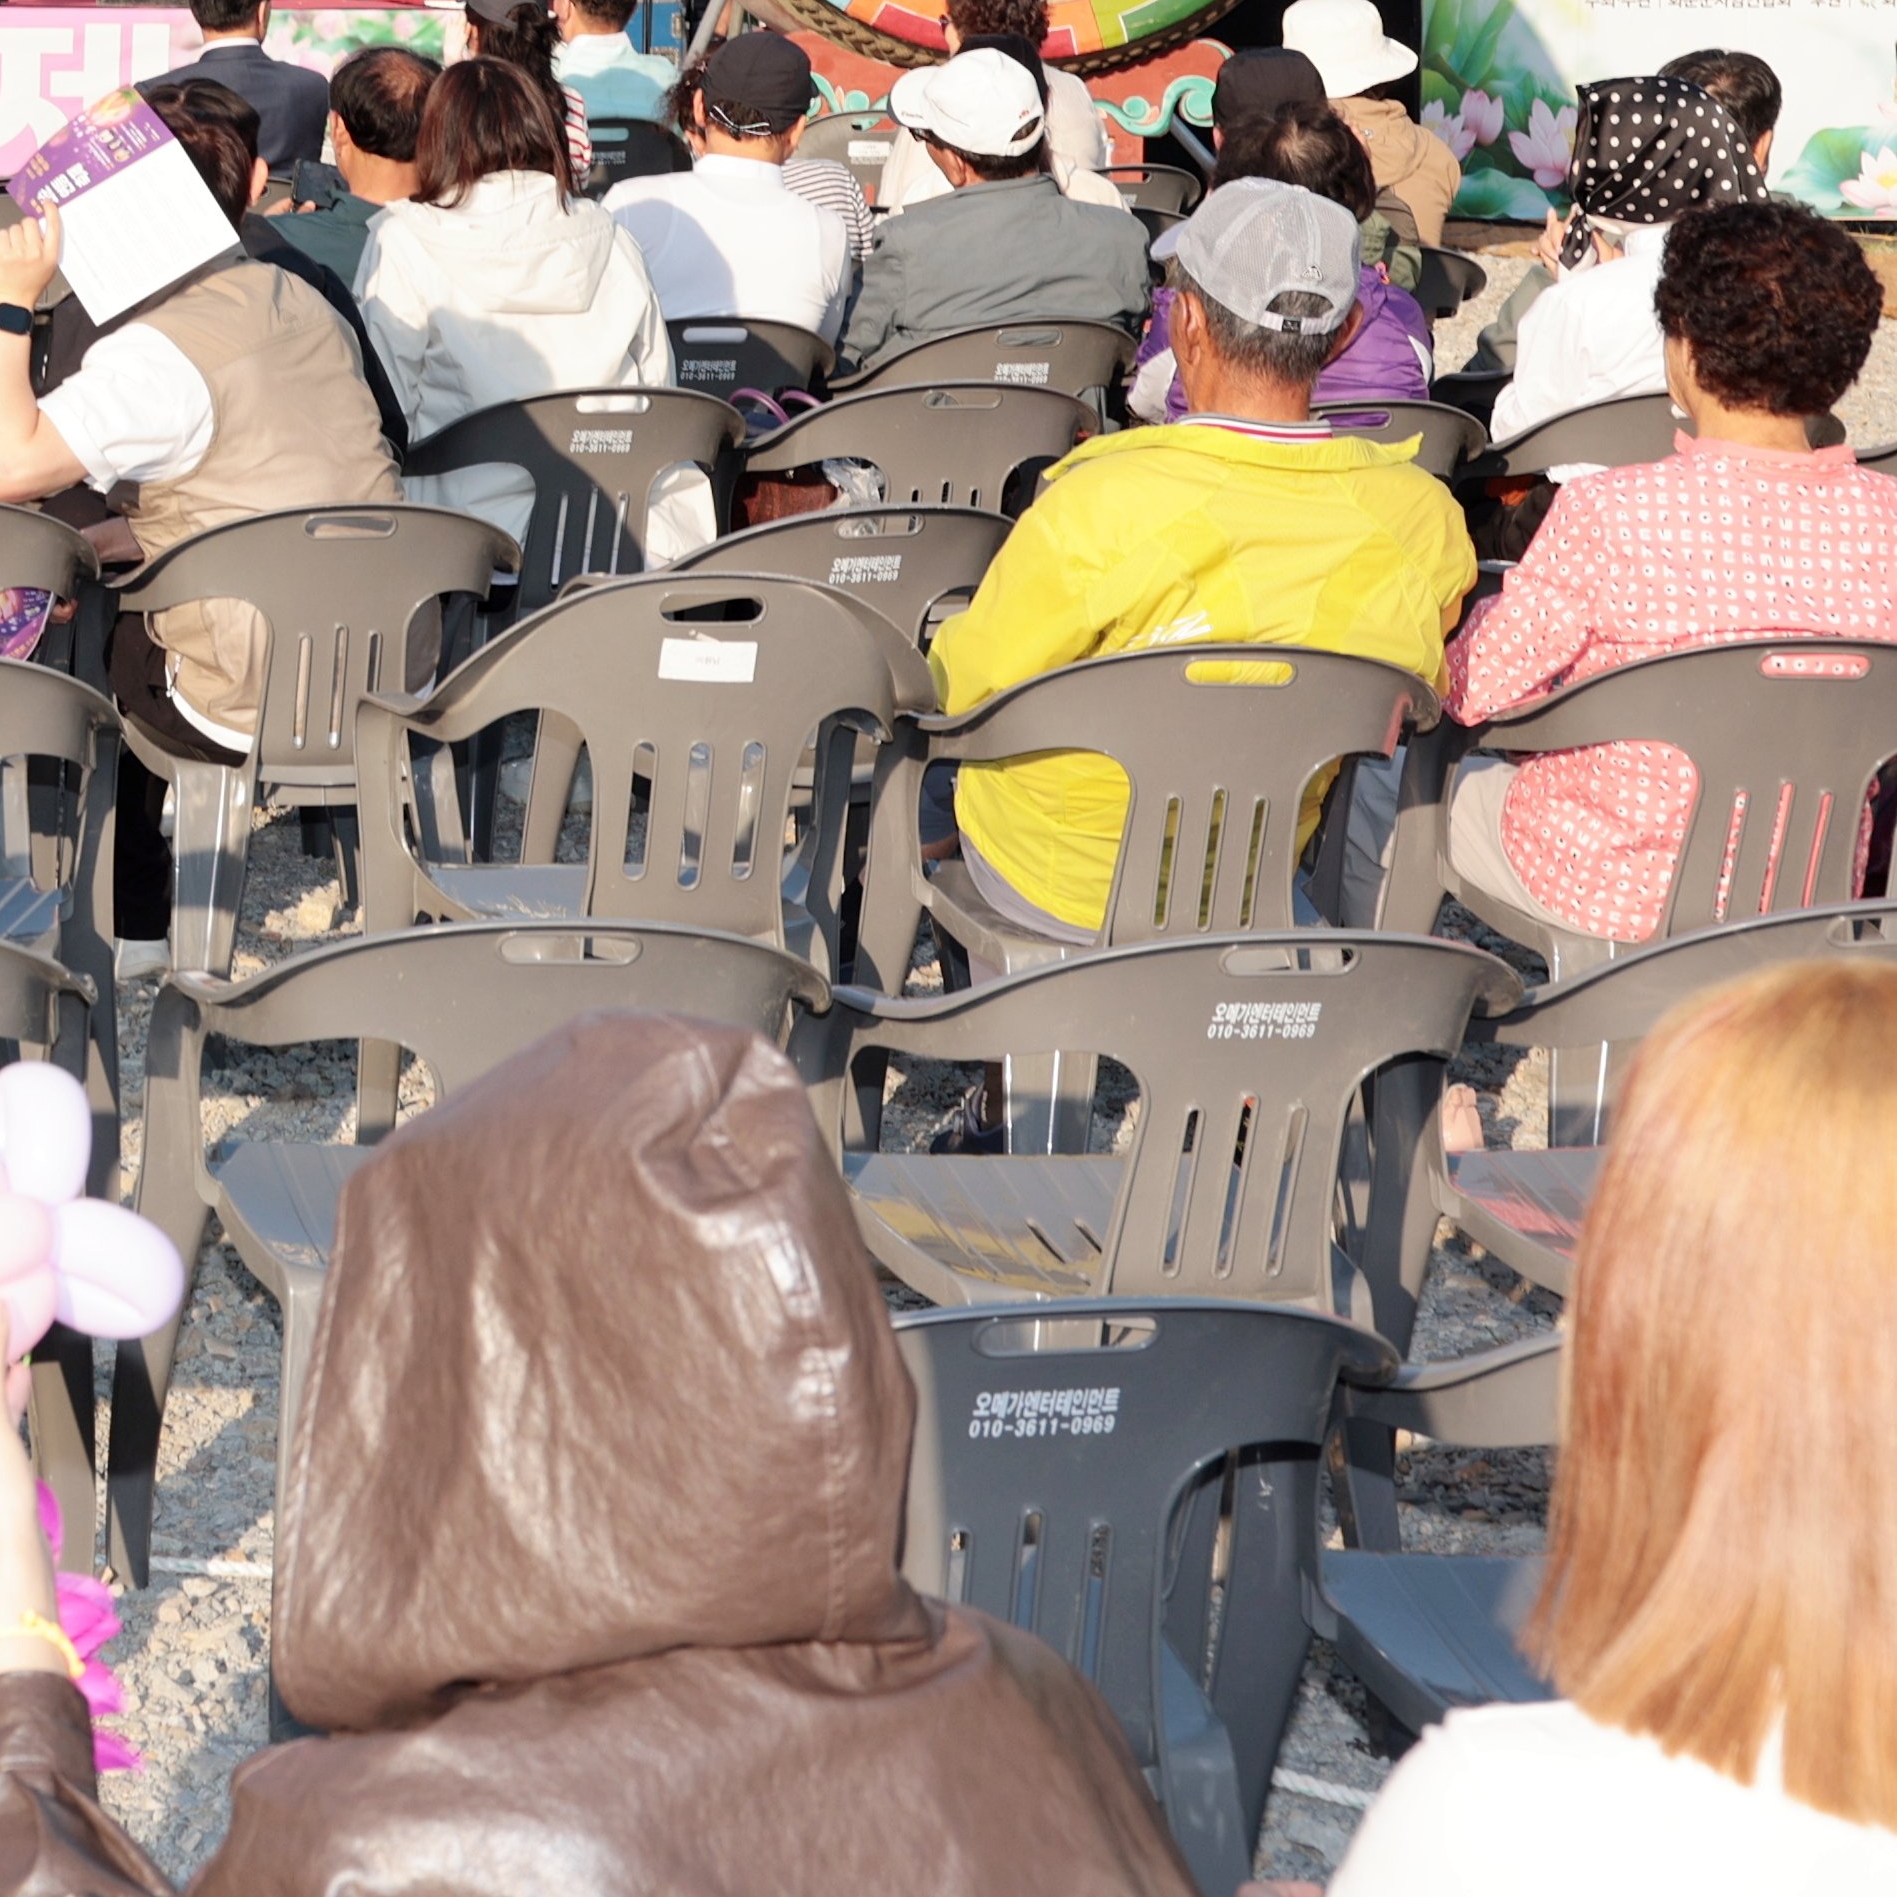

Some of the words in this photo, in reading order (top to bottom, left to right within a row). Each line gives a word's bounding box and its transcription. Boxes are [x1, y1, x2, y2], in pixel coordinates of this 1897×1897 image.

[1211, 1002, 1322, 1024] 오메가엔터테인먼트
[1207, 1023, 1316, 1039] 010-3611-0969
[972, 1387, 1121, 1419] 오메가엔터테인먼트
[968, 1414, 1116, 1438] 010-3611-0969
